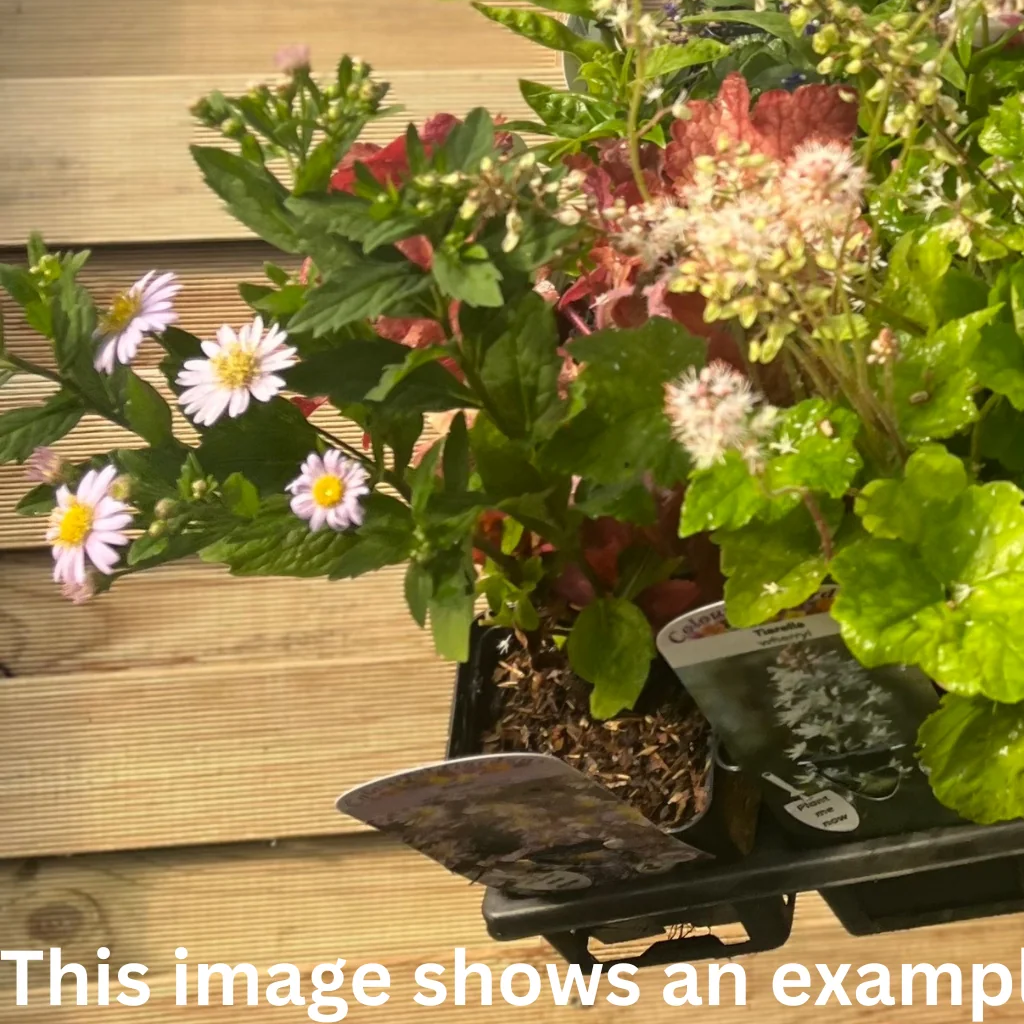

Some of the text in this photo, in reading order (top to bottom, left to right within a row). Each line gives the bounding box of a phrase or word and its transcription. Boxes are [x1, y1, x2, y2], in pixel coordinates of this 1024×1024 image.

[797, 795, 831, 812] Plant
[815, 806, 834, 818] me
[822, 813, 848, 828] now
